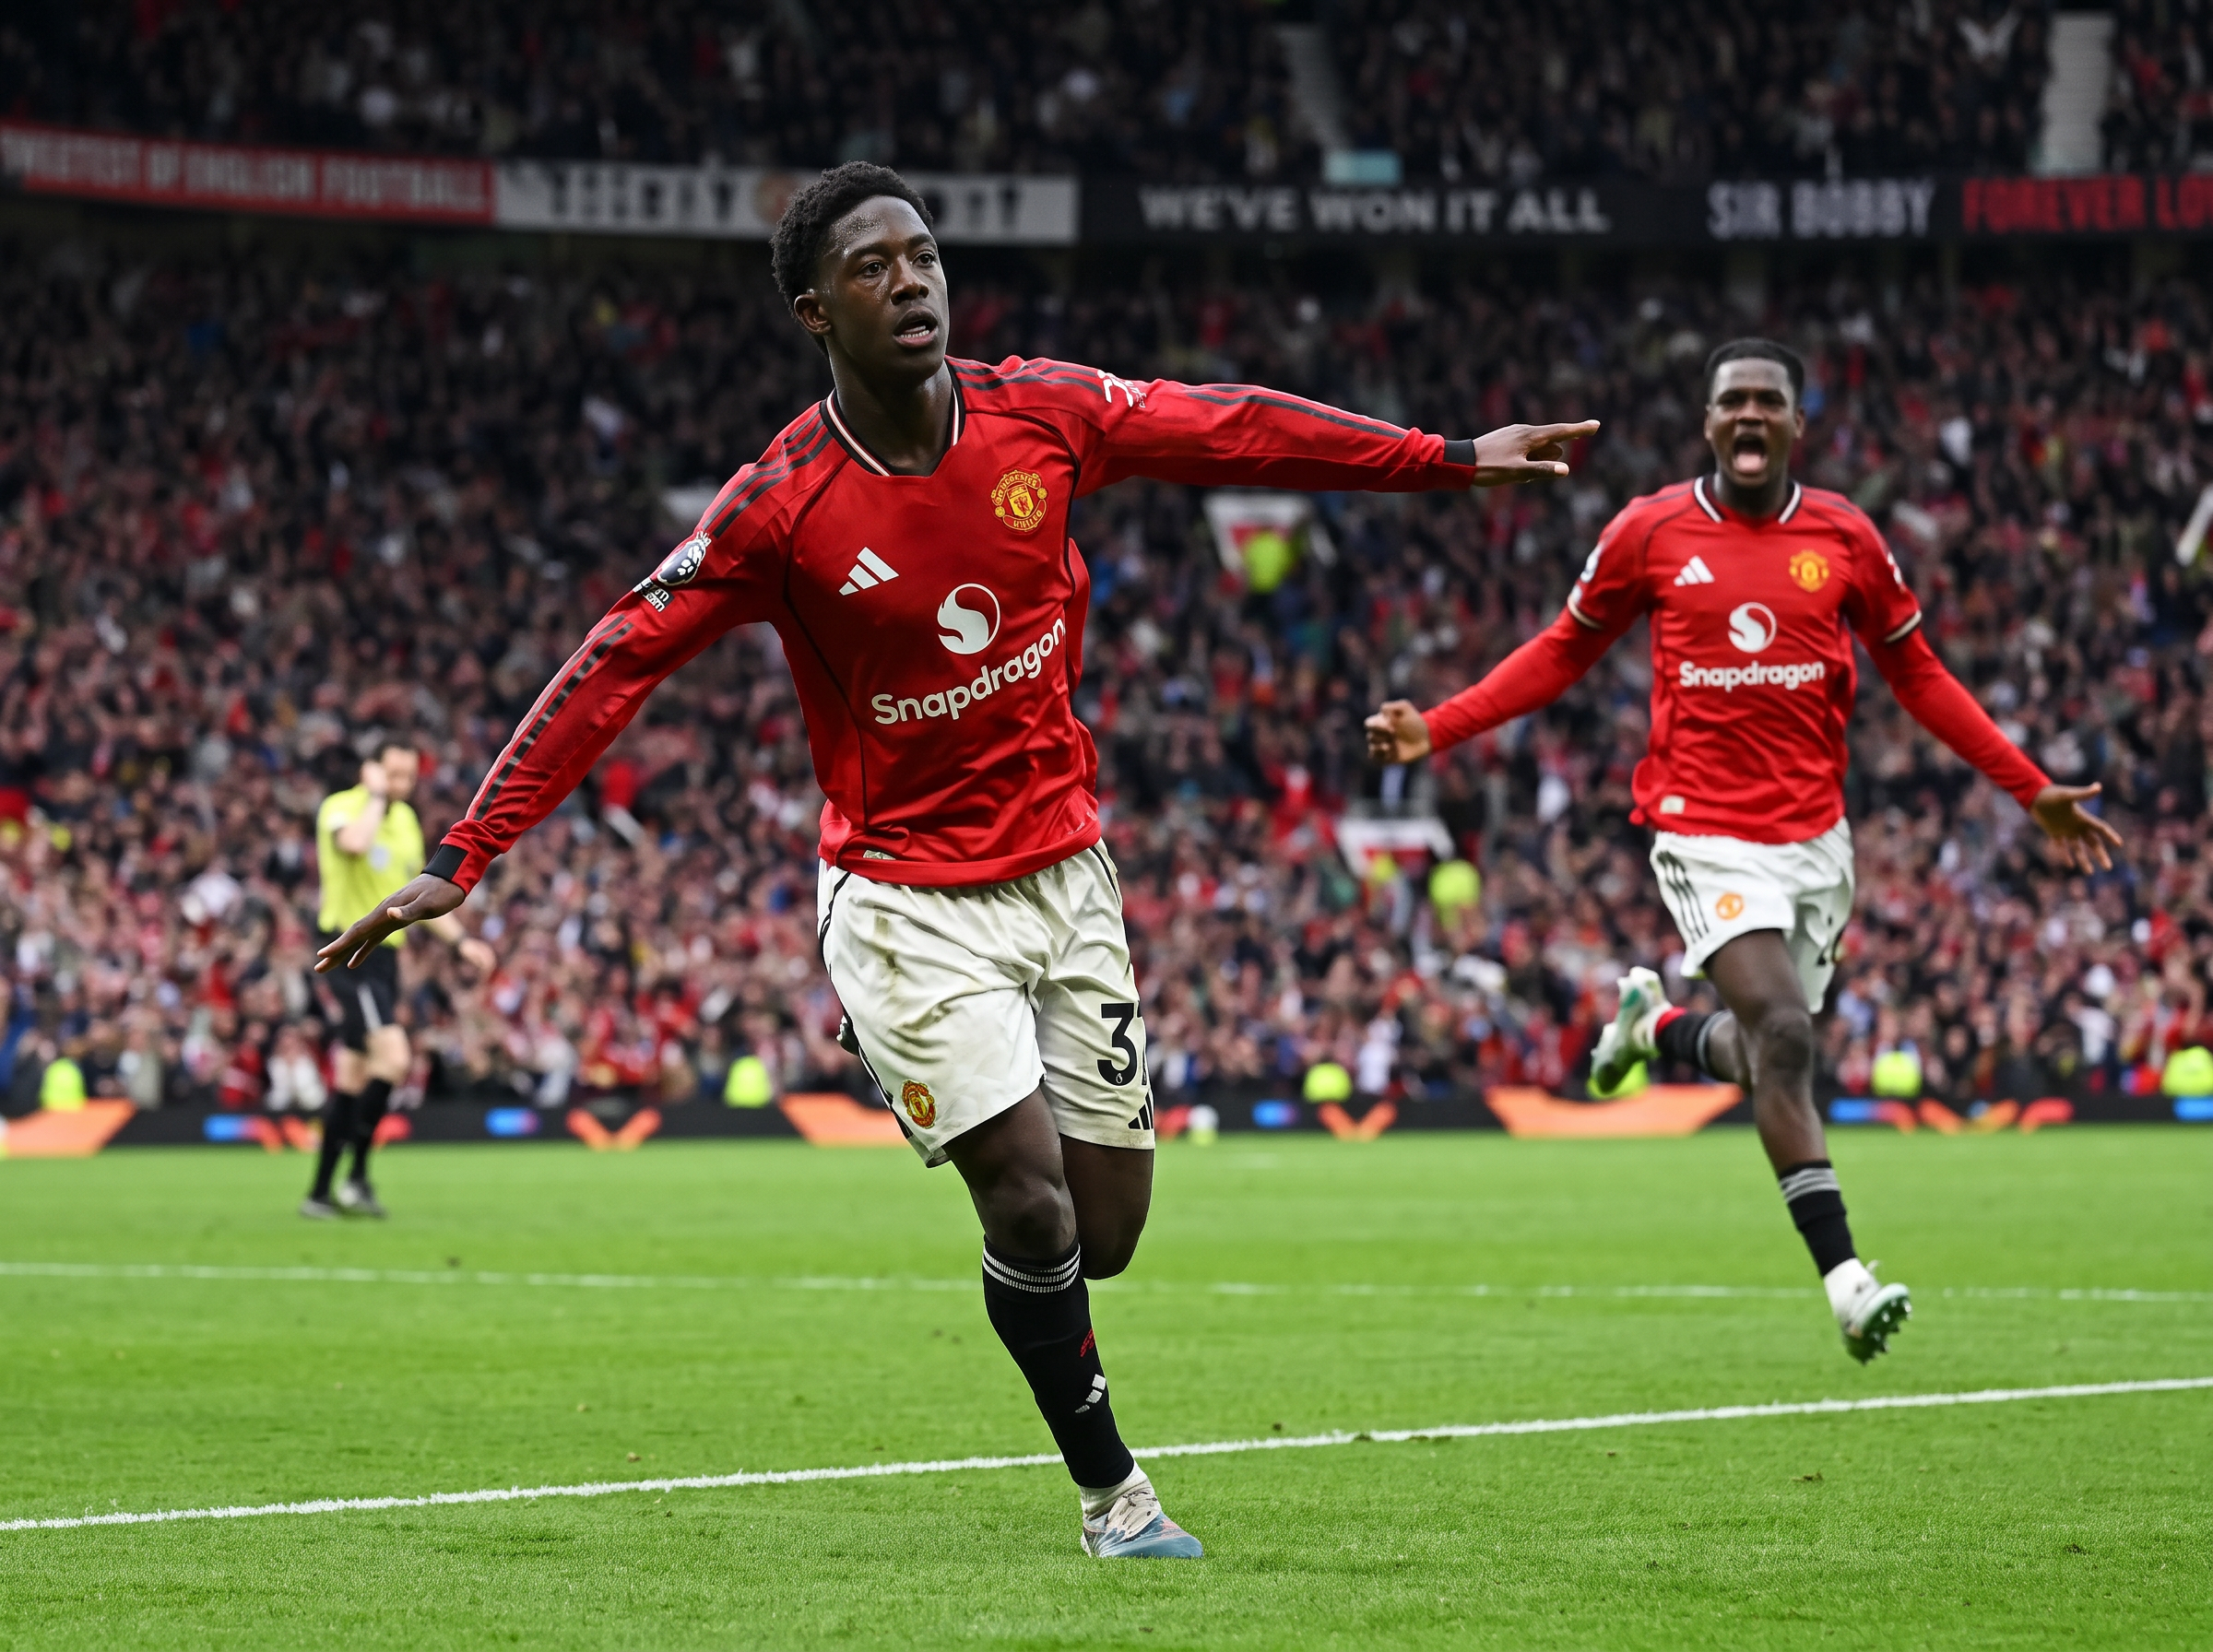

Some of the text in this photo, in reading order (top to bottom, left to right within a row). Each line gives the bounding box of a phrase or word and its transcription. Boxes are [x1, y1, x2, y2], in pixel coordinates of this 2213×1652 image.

[1140, 188, 1612, 233] WE'VE WON IT ALL
[1706, 181, 1935, 240] SIR BOBBY
[871, 618, 1066, 725] Snapdragon
[1678, 660, 1825, 692] Snapdragon
[1096, 1000, 1147, 1086] 3
